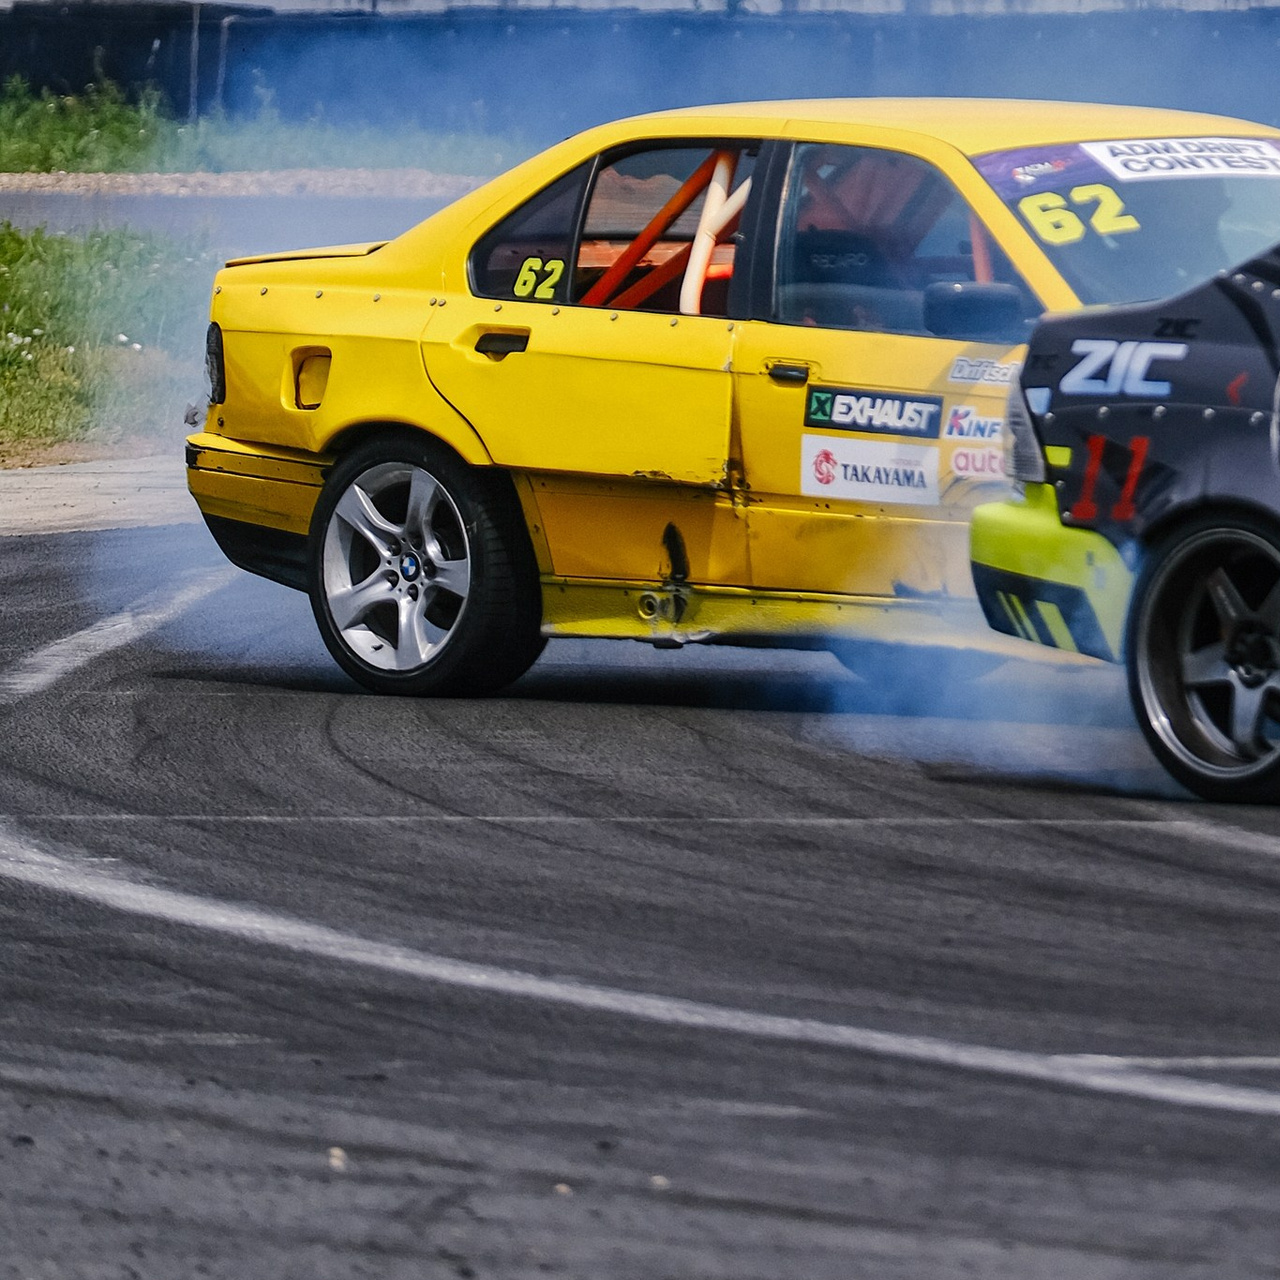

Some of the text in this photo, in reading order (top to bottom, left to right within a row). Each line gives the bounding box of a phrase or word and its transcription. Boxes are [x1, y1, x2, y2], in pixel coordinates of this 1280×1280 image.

[1106, 140, 1268, 158] ADM DRIFT
[1018, 183, 1141, 246] 62
[513, 256, 565, 300] 62
[1059, 338, 1189, 397] ZIC
[831, 394, 941, 430] EXHAUST
[841, 463, 928, 489] TAKAYAMA
[1072, 434, 1149, 522] 11
